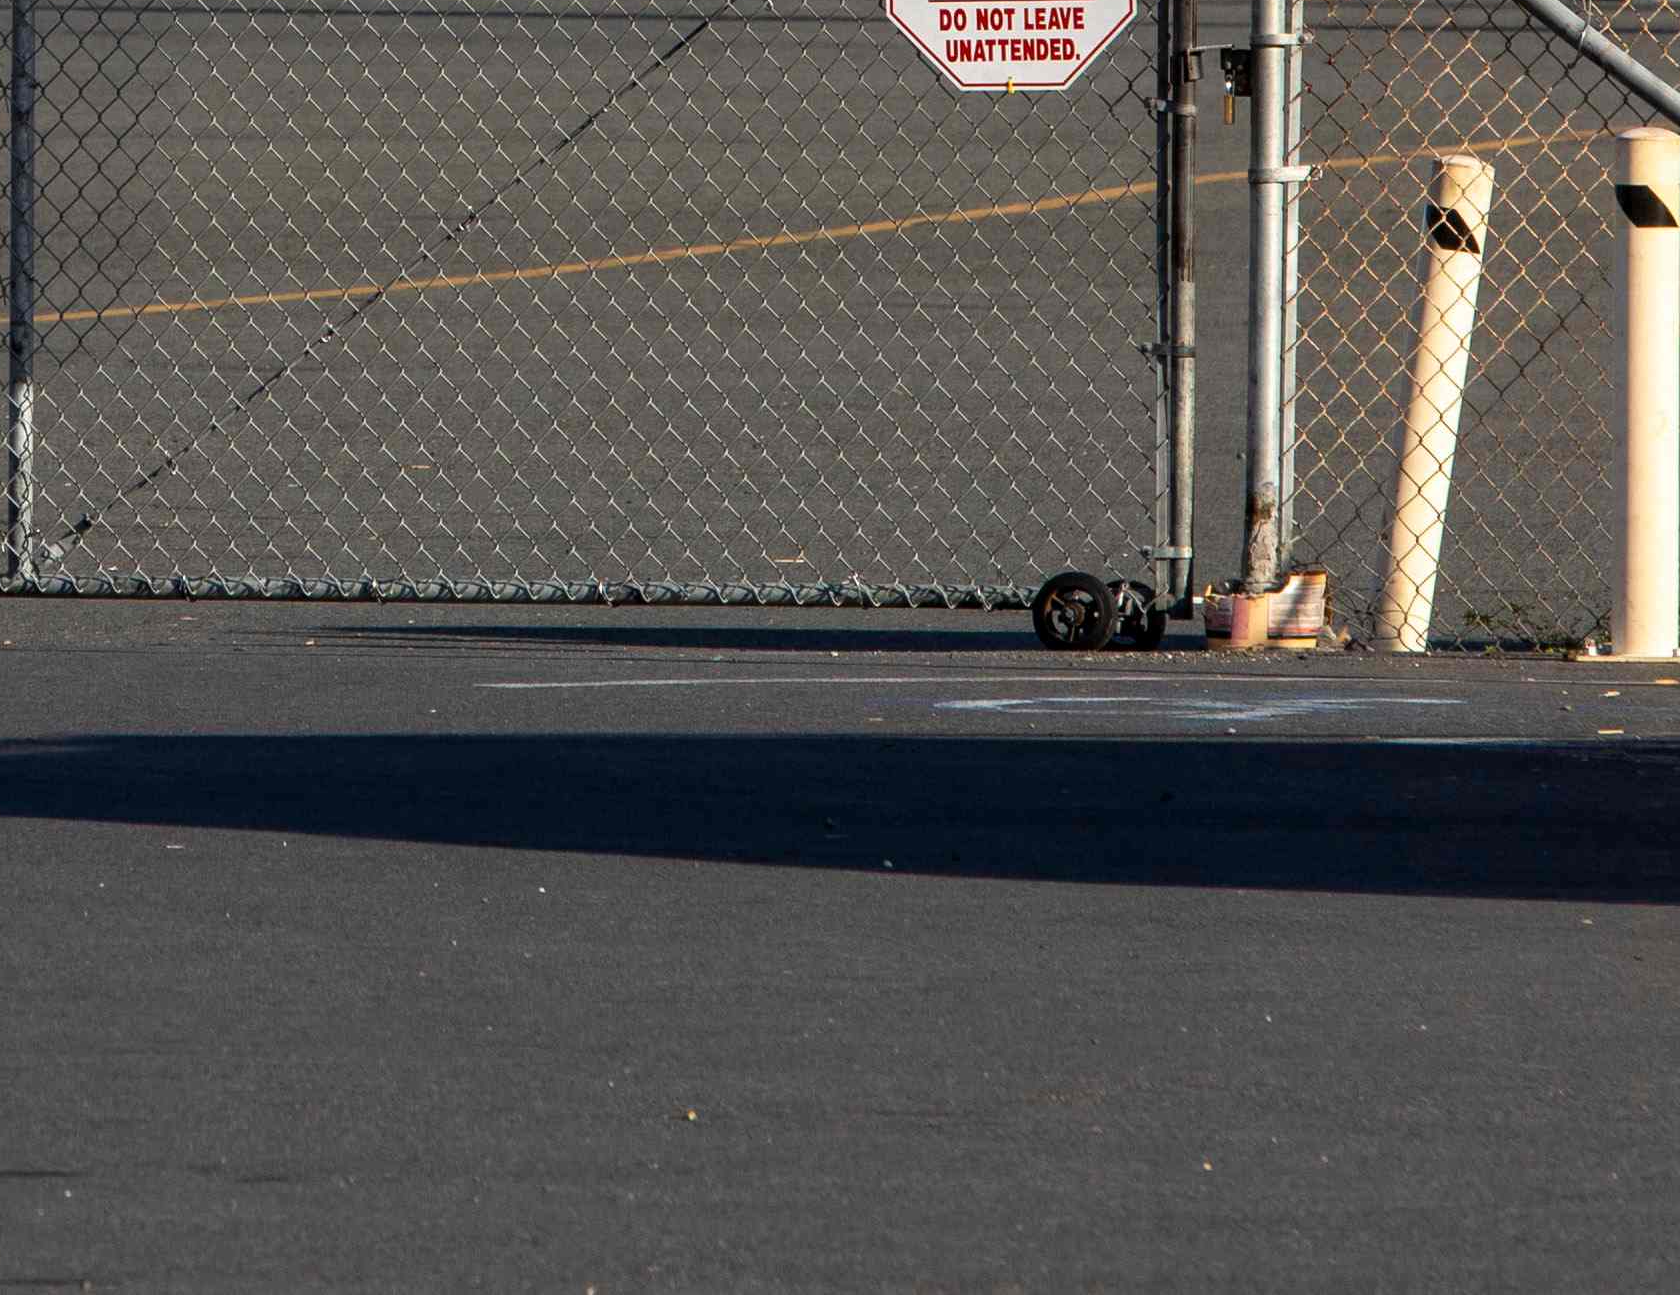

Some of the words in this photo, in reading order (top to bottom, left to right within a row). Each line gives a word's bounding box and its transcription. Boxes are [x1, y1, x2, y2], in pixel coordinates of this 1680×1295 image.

[939, 8, 967, 31] DO
[976, 8, 1016, 31] NOT
[1024, 7, 1085, 30] LEAVE
[946, 38, 1081, 62] UNATTENDED.
